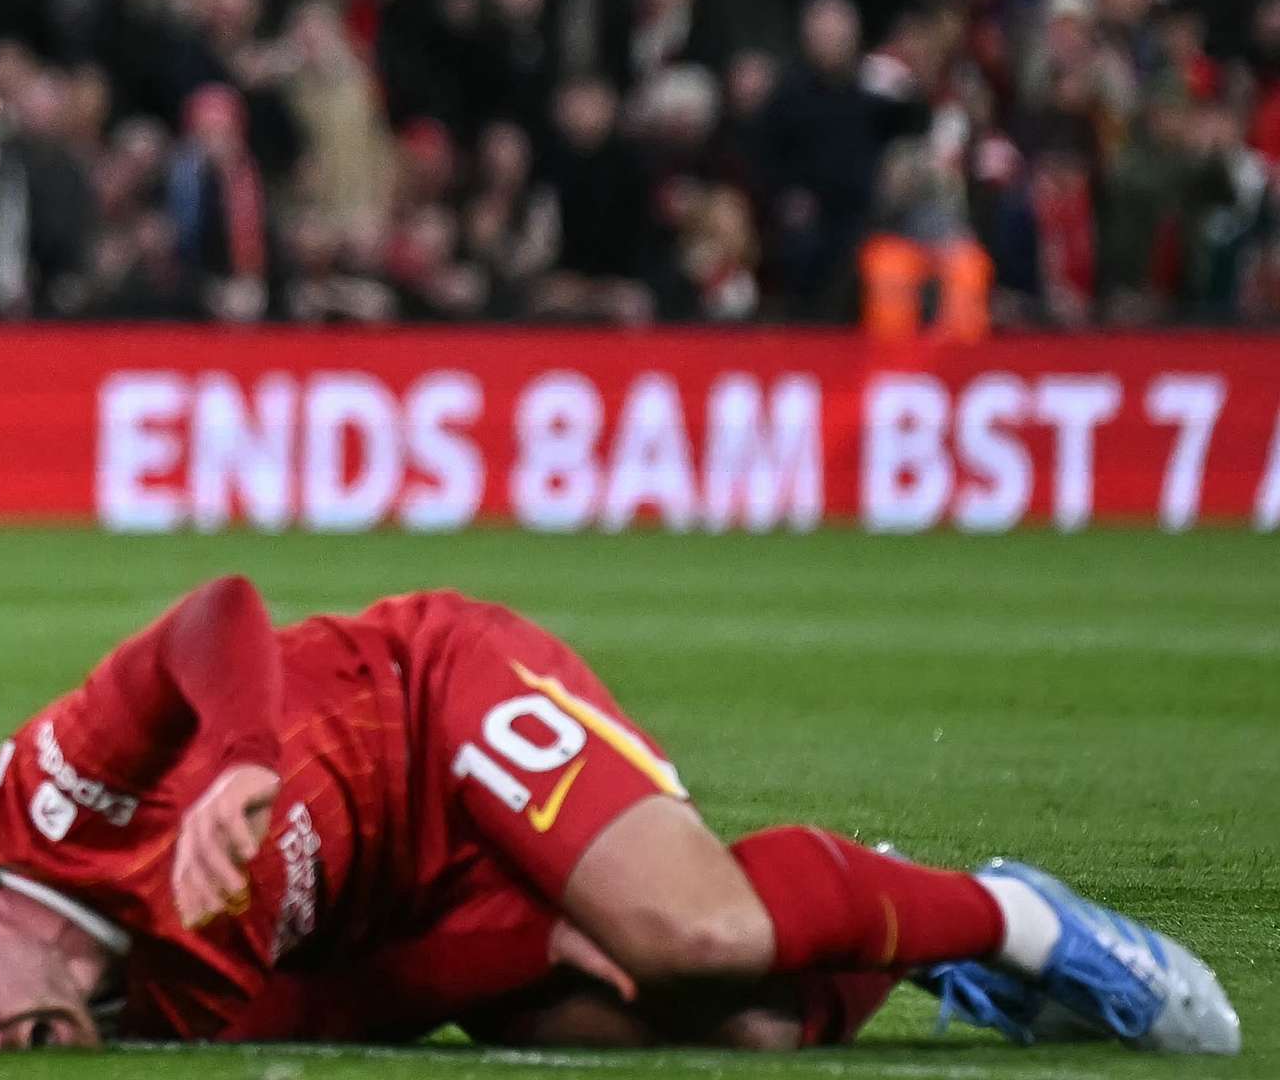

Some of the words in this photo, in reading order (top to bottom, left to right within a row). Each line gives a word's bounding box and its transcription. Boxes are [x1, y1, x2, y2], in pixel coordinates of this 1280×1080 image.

[95, 369, 486, 534] ENDS
[509, 369, 825, 534] 8AM
[860, 371, 1124, 534] BST
[1143, 372, 1229, 534] 7
[452, 694, 587, 813] 10
